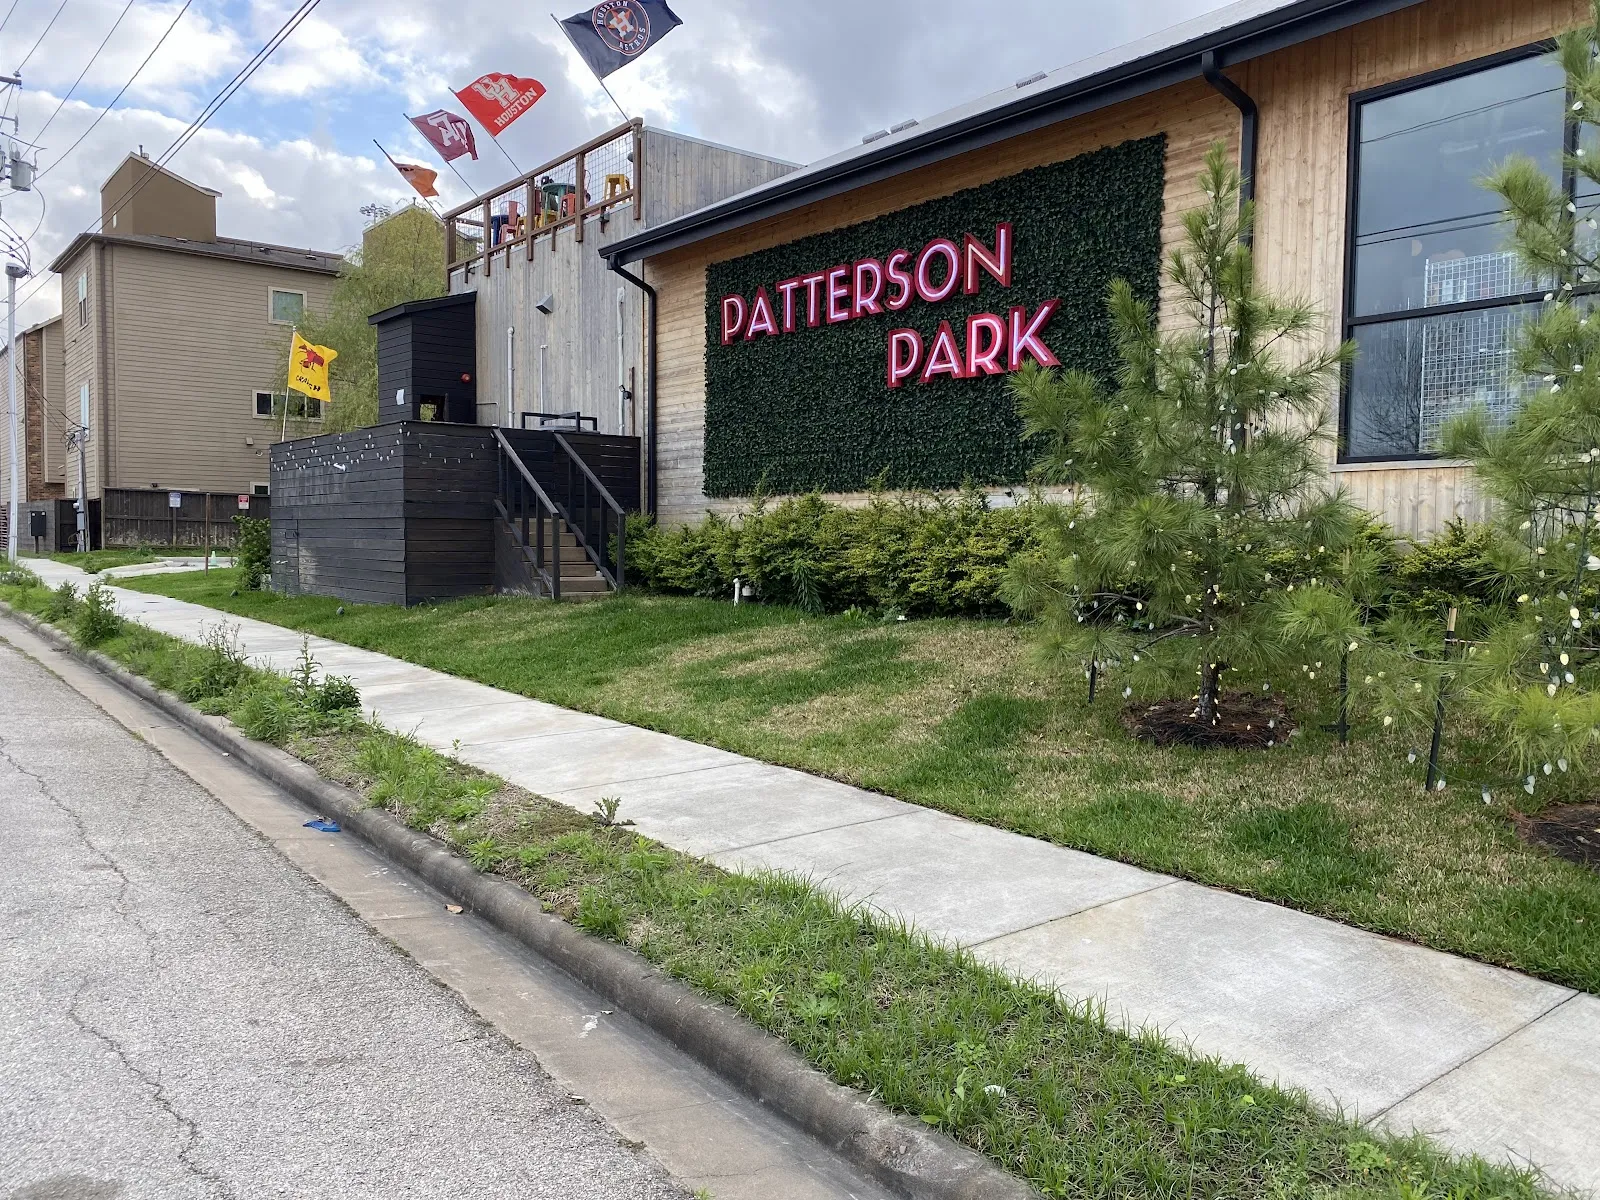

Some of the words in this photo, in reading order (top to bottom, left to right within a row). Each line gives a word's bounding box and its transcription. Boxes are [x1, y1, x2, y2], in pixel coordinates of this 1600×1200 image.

[597, 0, 629, 25] HOUSTON
[609, 11, 634, 38] H
[619, 27, 646, 51] ASTROS
[493, 87, 538, 127] HOUSTON
[721, 222, 1012, 346] PATTERSON
[887, 298, 1062, 388] PARK
